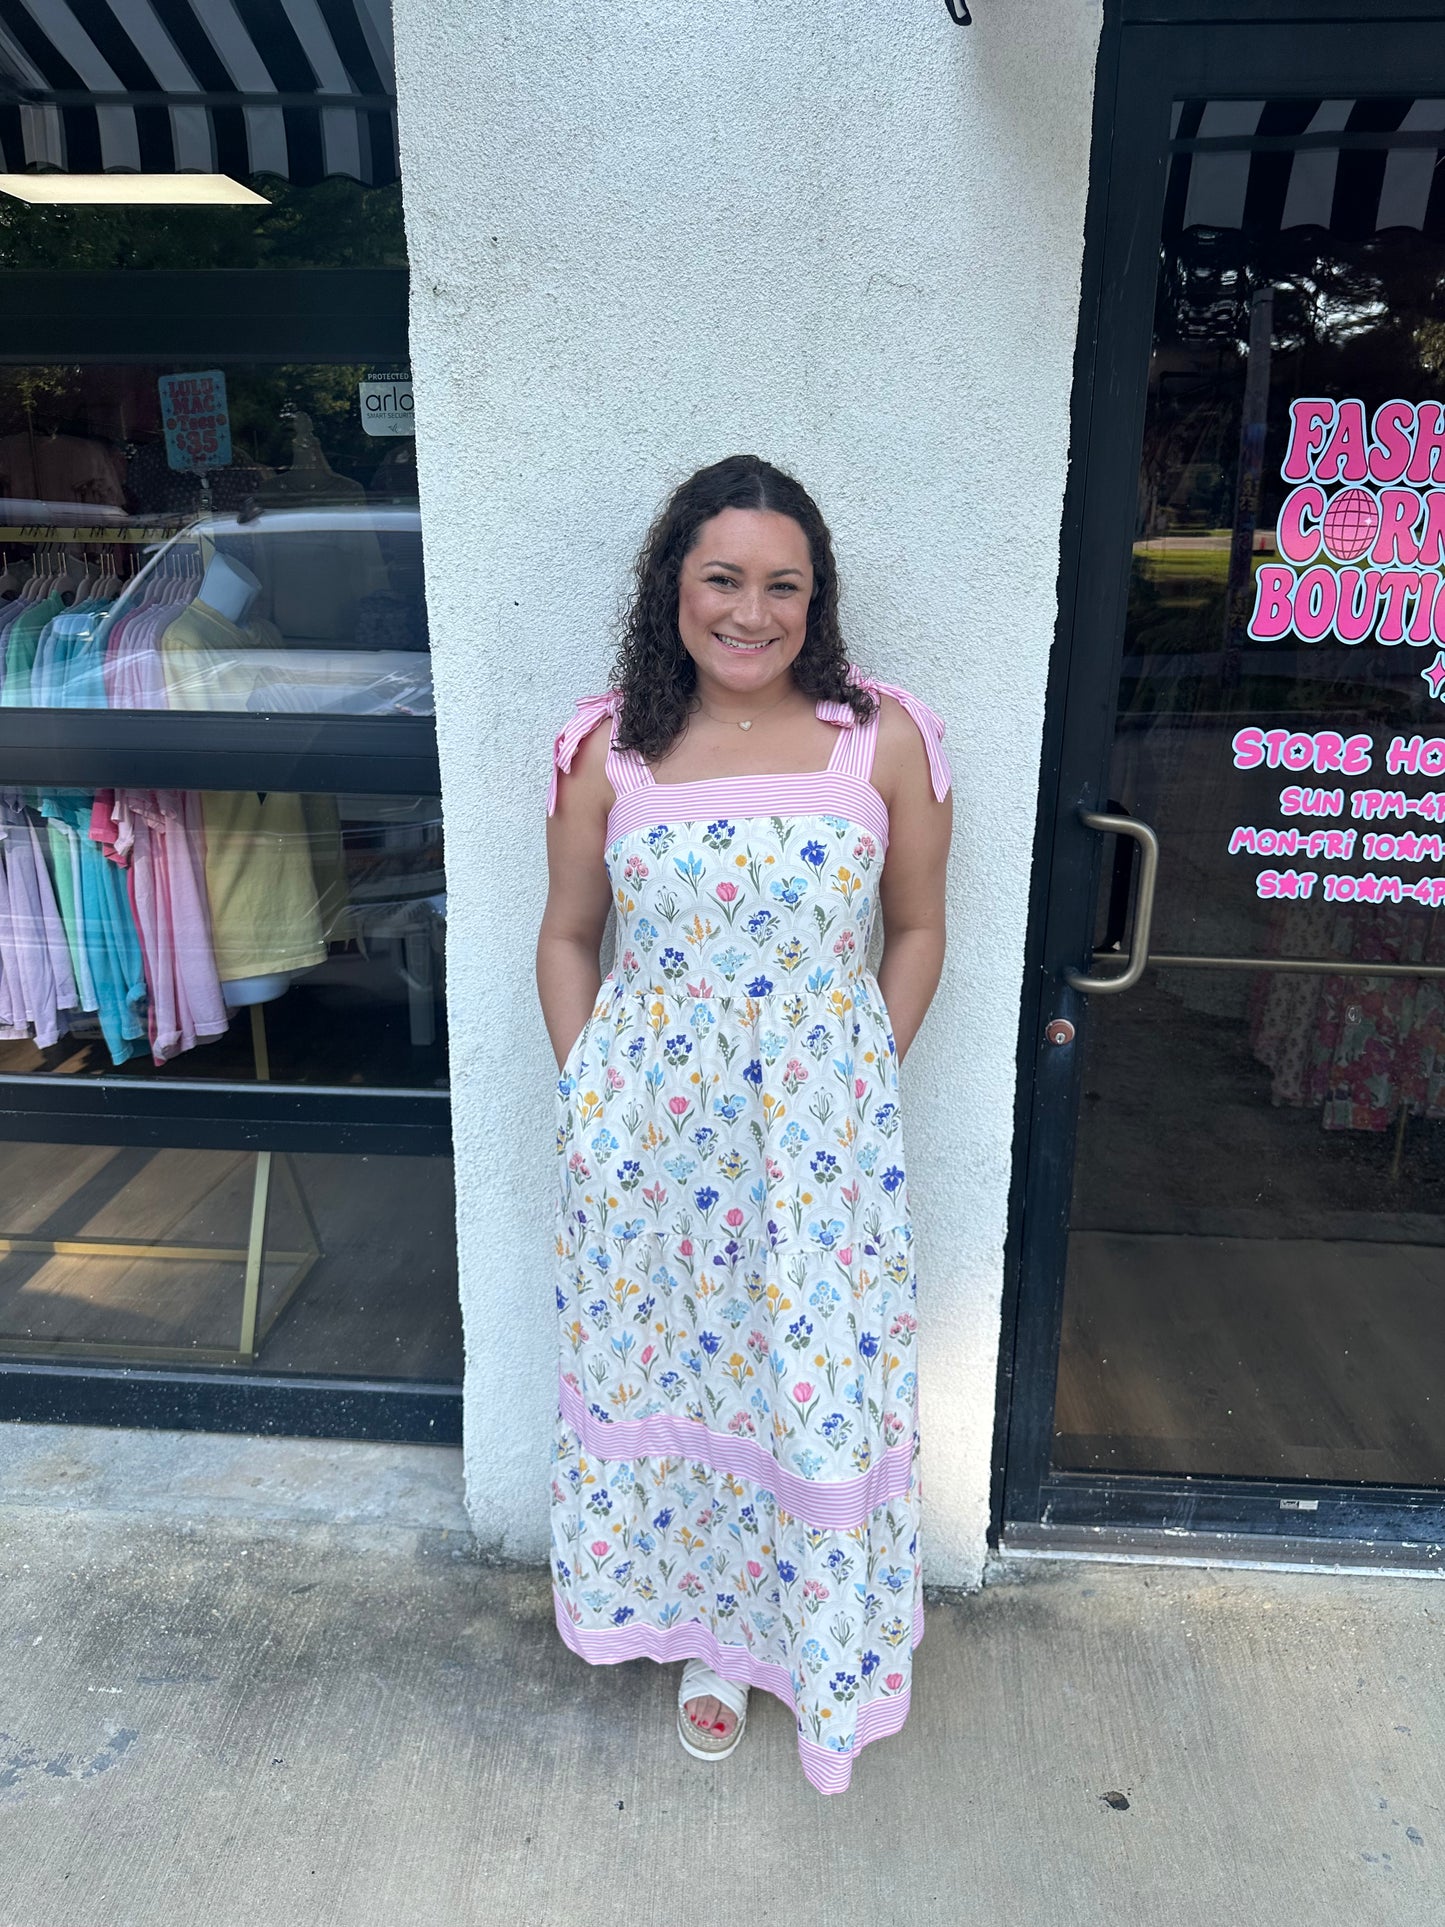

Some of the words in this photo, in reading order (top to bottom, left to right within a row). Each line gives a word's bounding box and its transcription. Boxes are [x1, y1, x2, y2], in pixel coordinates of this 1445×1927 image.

[172, 395, 215, 416] MAC
[365, 385, 414, 411] arlo
[176, 430, 219, 455] $35
[1247, 563, 1445, 646] BOUTI
[1232, 727, 1373, 775] STORE
[1279, 786, 1344, 817] SUN
